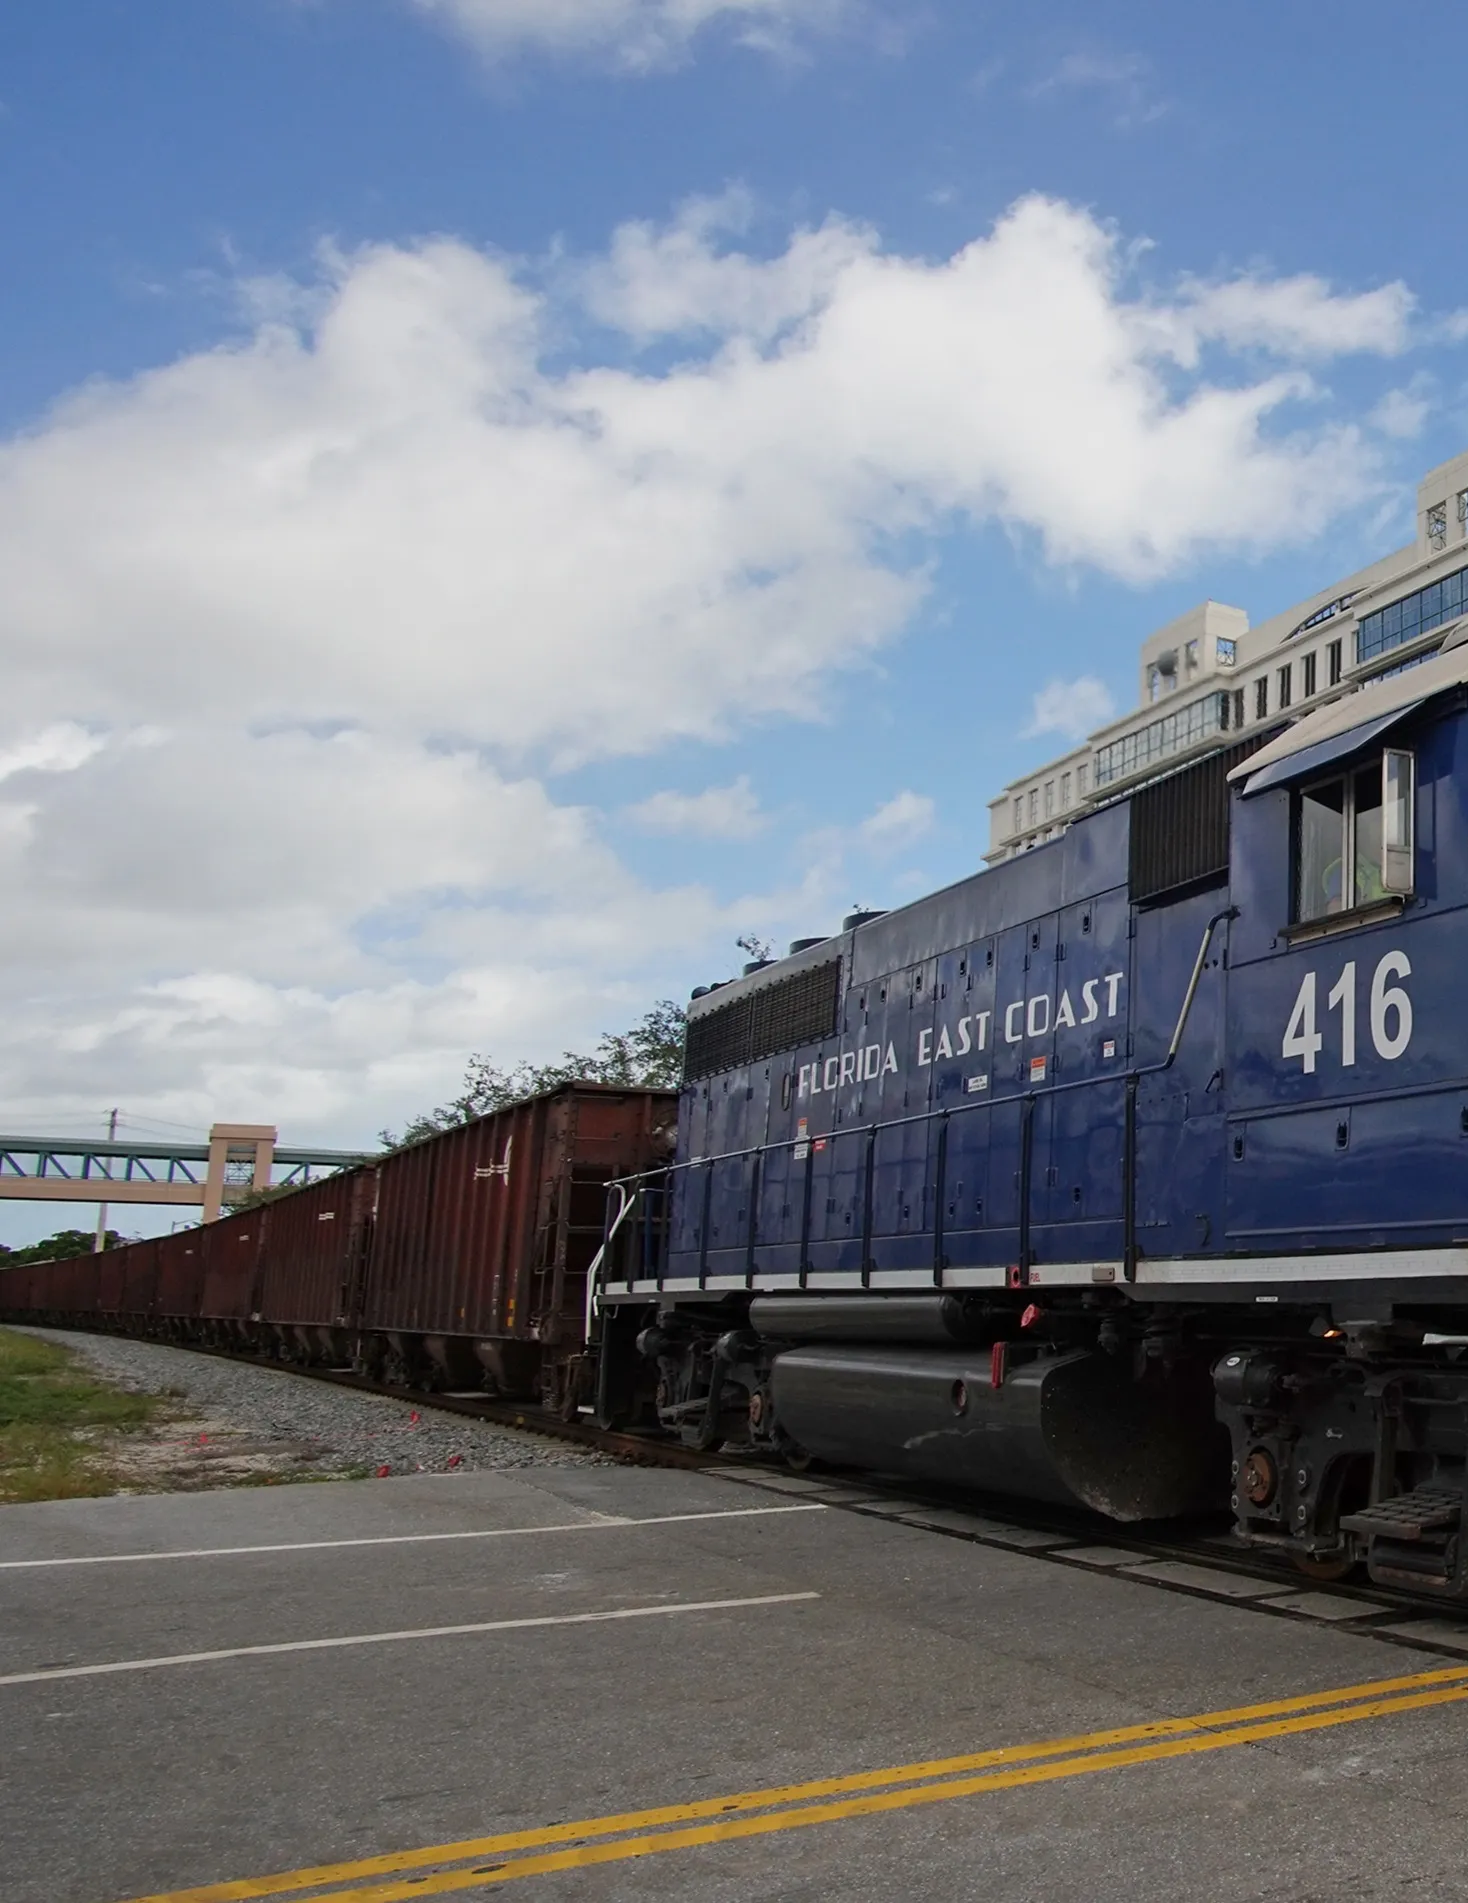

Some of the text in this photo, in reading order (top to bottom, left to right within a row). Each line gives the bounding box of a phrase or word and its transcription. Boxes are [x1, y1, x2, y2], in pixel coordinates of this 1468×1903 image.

[797, 972, 1124, 1099] FLORIDA EAST COAST
[1281, 949, 1413, 1075] 416
